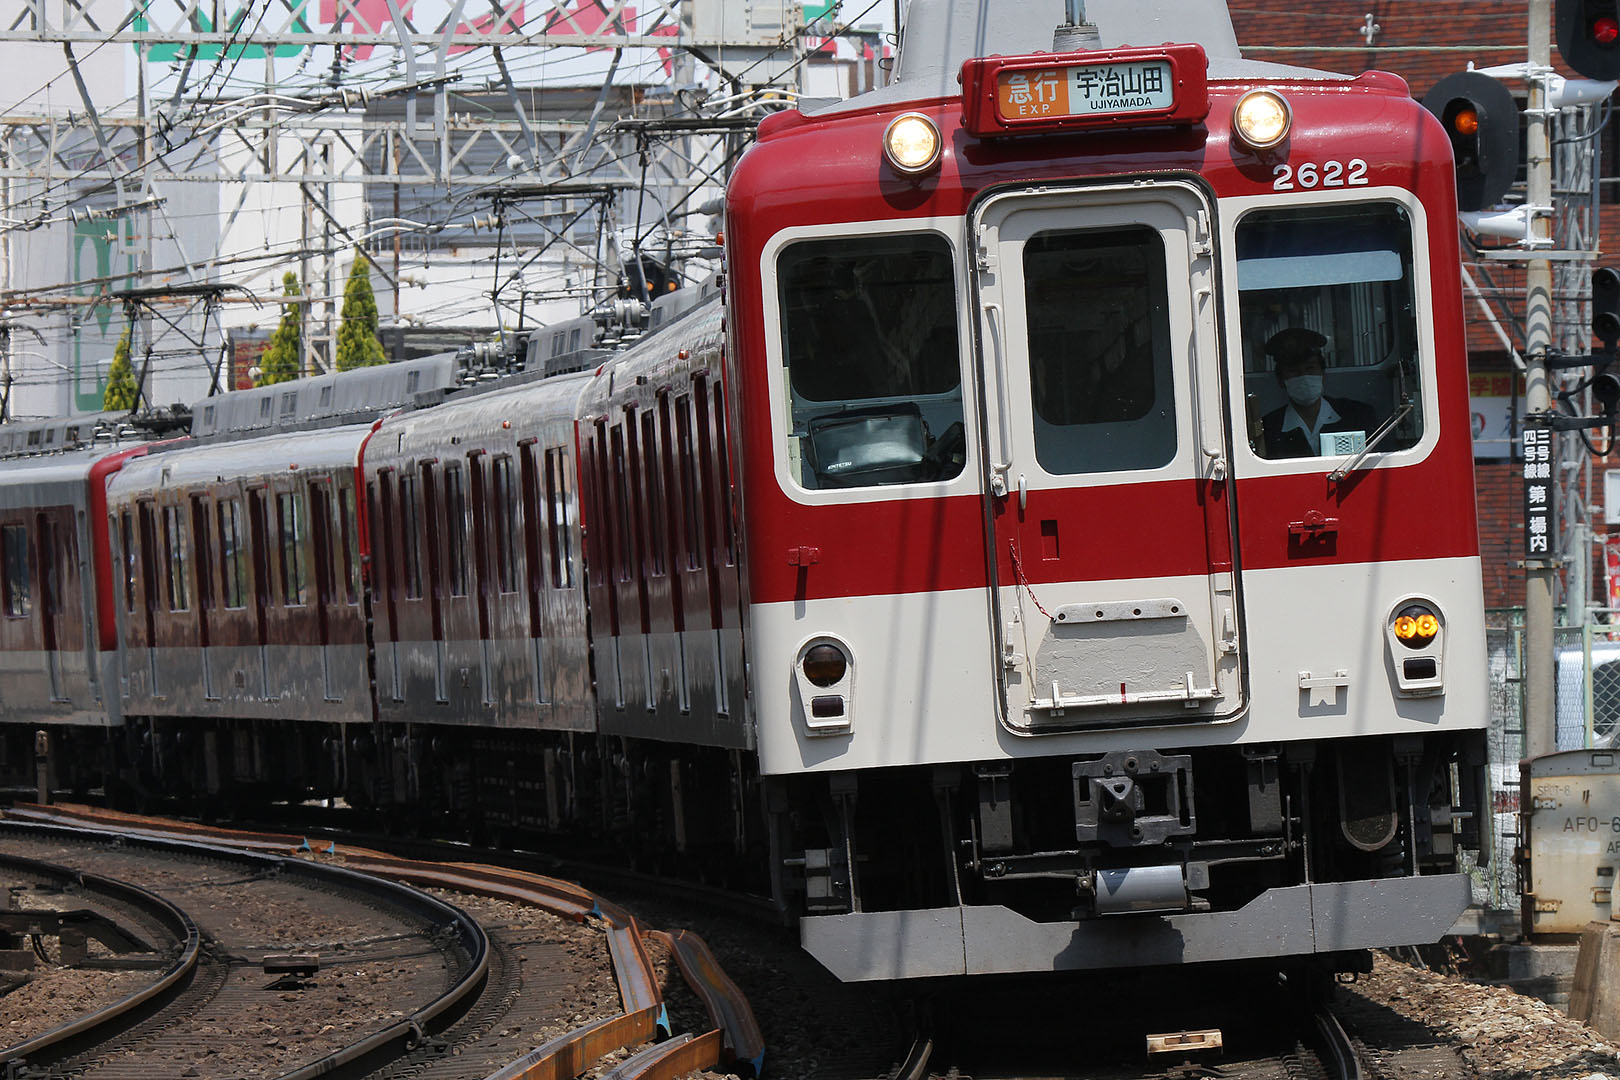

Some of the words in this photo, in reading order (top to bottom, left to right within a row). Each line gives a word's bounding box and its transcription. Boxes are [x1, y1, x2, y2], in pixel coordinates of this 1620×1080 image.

[1007, 71, 1059, 105] 急行
[1076, 66, 1163, 99] 宇治山田
[1090, 97, 1152, 110] UJIYAMADA
[1273, 158, 1369, 191] 2622
[1523, 430, 1537, 479] 四号線
[1537, 429, 1550, 478] 三号線
[1529, 485, 1548, 552] 第一場内
